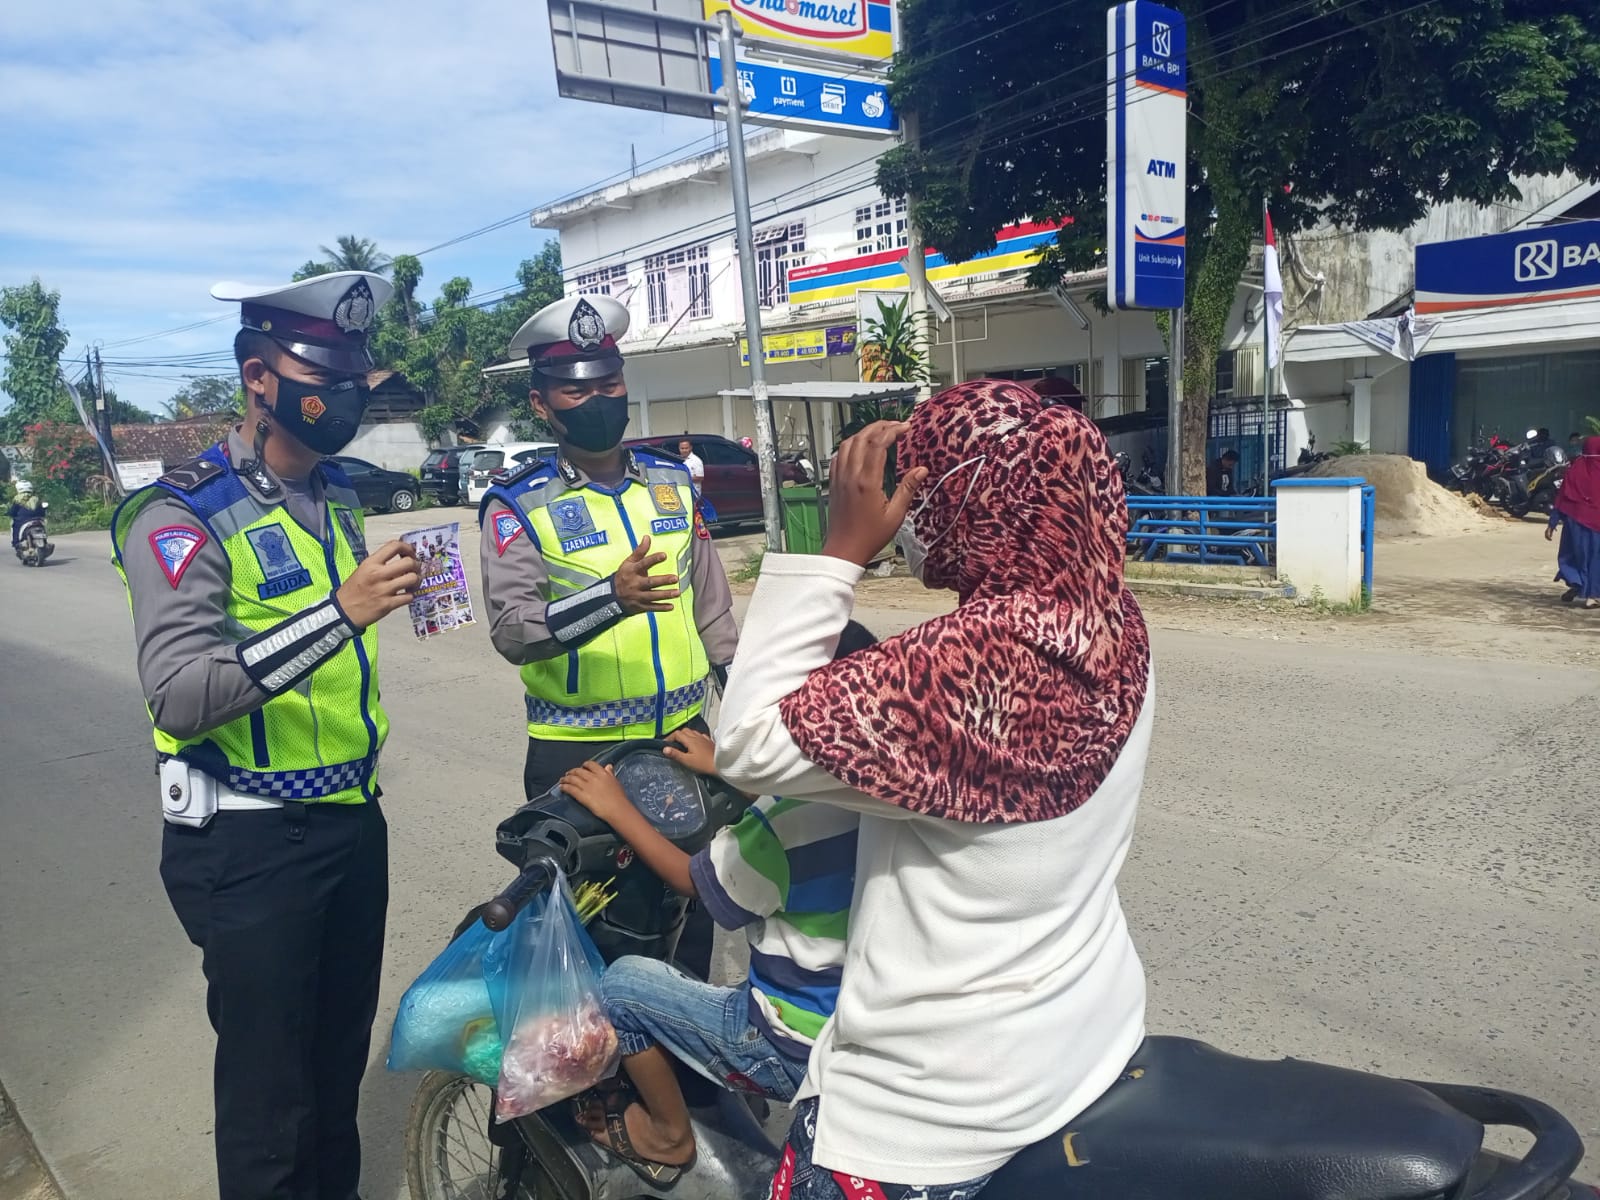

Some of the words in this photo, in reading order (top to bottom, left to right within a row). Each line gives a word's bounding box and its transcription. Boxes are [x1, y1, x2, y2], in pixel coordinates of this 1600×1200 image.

[1142, 55, 1165, 72] BANK
[773, 96, 805, 107] payment
[1146, 158, 1176, 179] ATM
[303, 415, 316, 425] TNI
[653, 517, 687, 532] POLRI
[265, 574, 309, 596] HUDA
